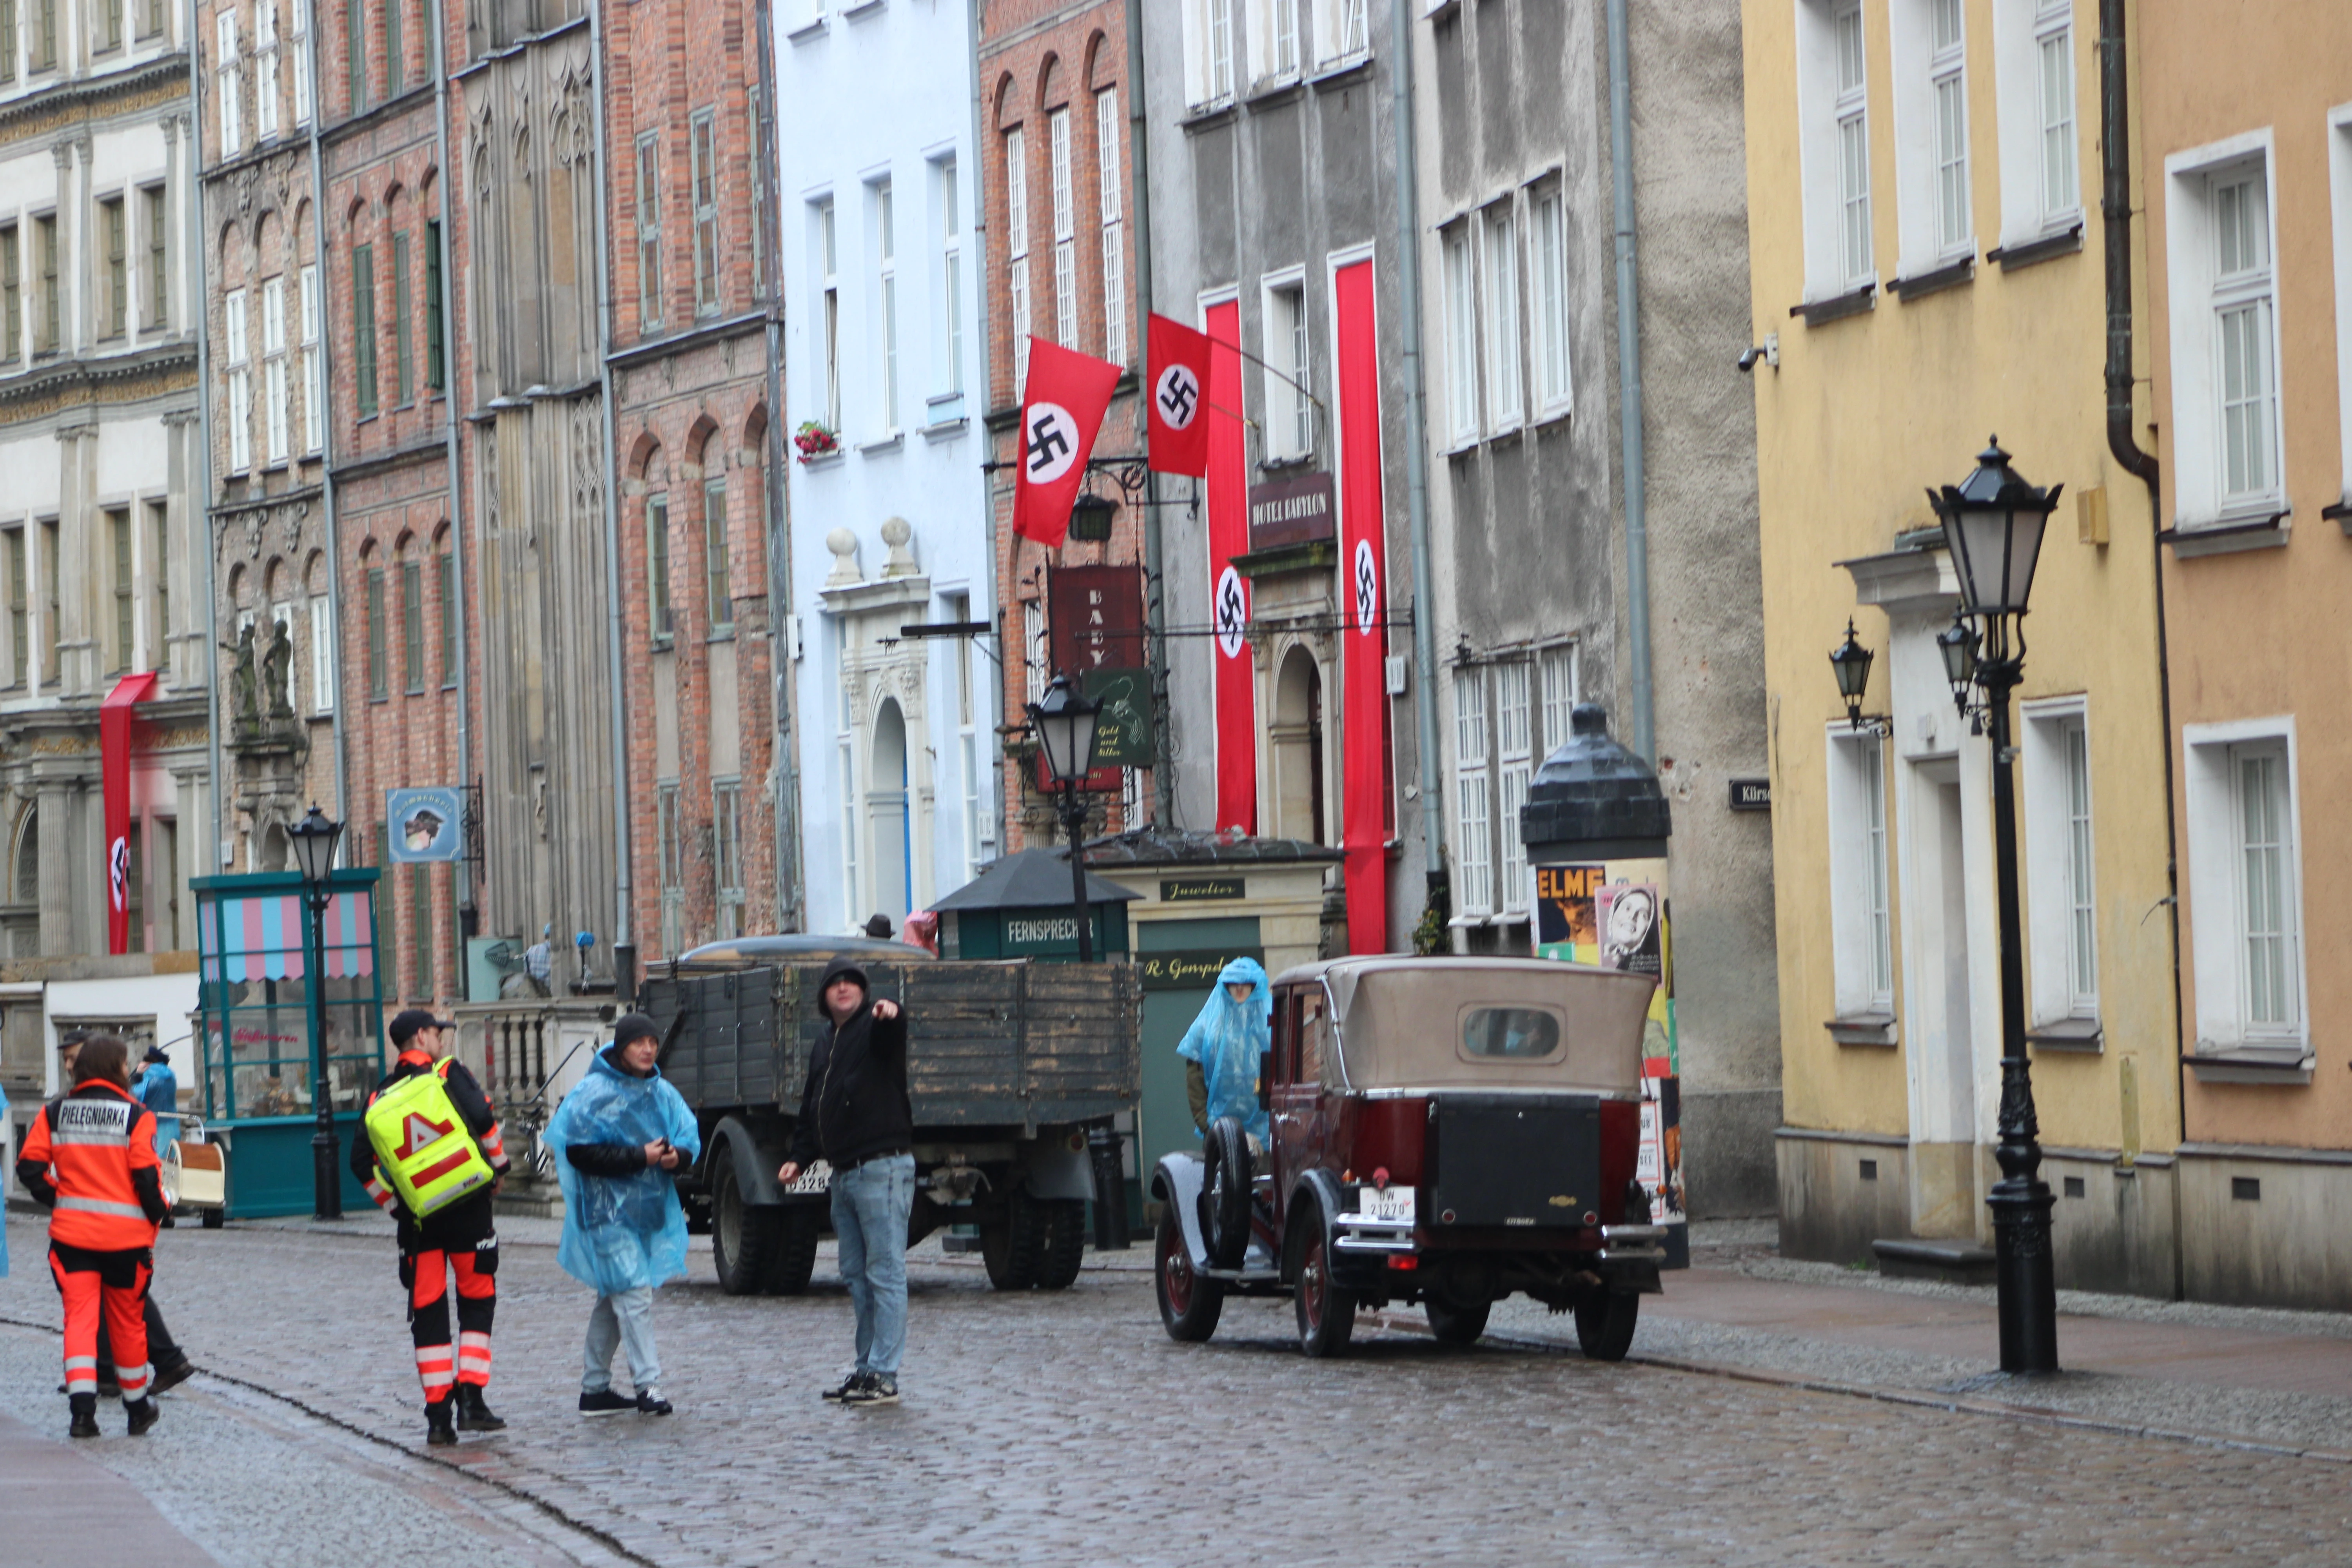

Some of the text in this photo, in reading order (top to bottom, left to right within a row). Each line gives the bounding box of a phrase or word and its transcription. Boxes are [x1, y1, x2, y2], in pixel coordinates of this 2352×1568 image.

[1253, 491, 1326, 526] HOTEL BABYLON
[1098, 725, 1120, 738] Gold
[1100, 736, 1118, 746] und
[1098, 747, 1121, 757] Silber
[1170, 882, 1236, 900] Juwelier
[1009, 917, 1094, 943] FERNSPRECHR
[1145, 959, 1163, 977] R
[61, 1105, 125, 1127] PIELĘGNIARKA
[1371, 1203, 1405, 1216] 21270
